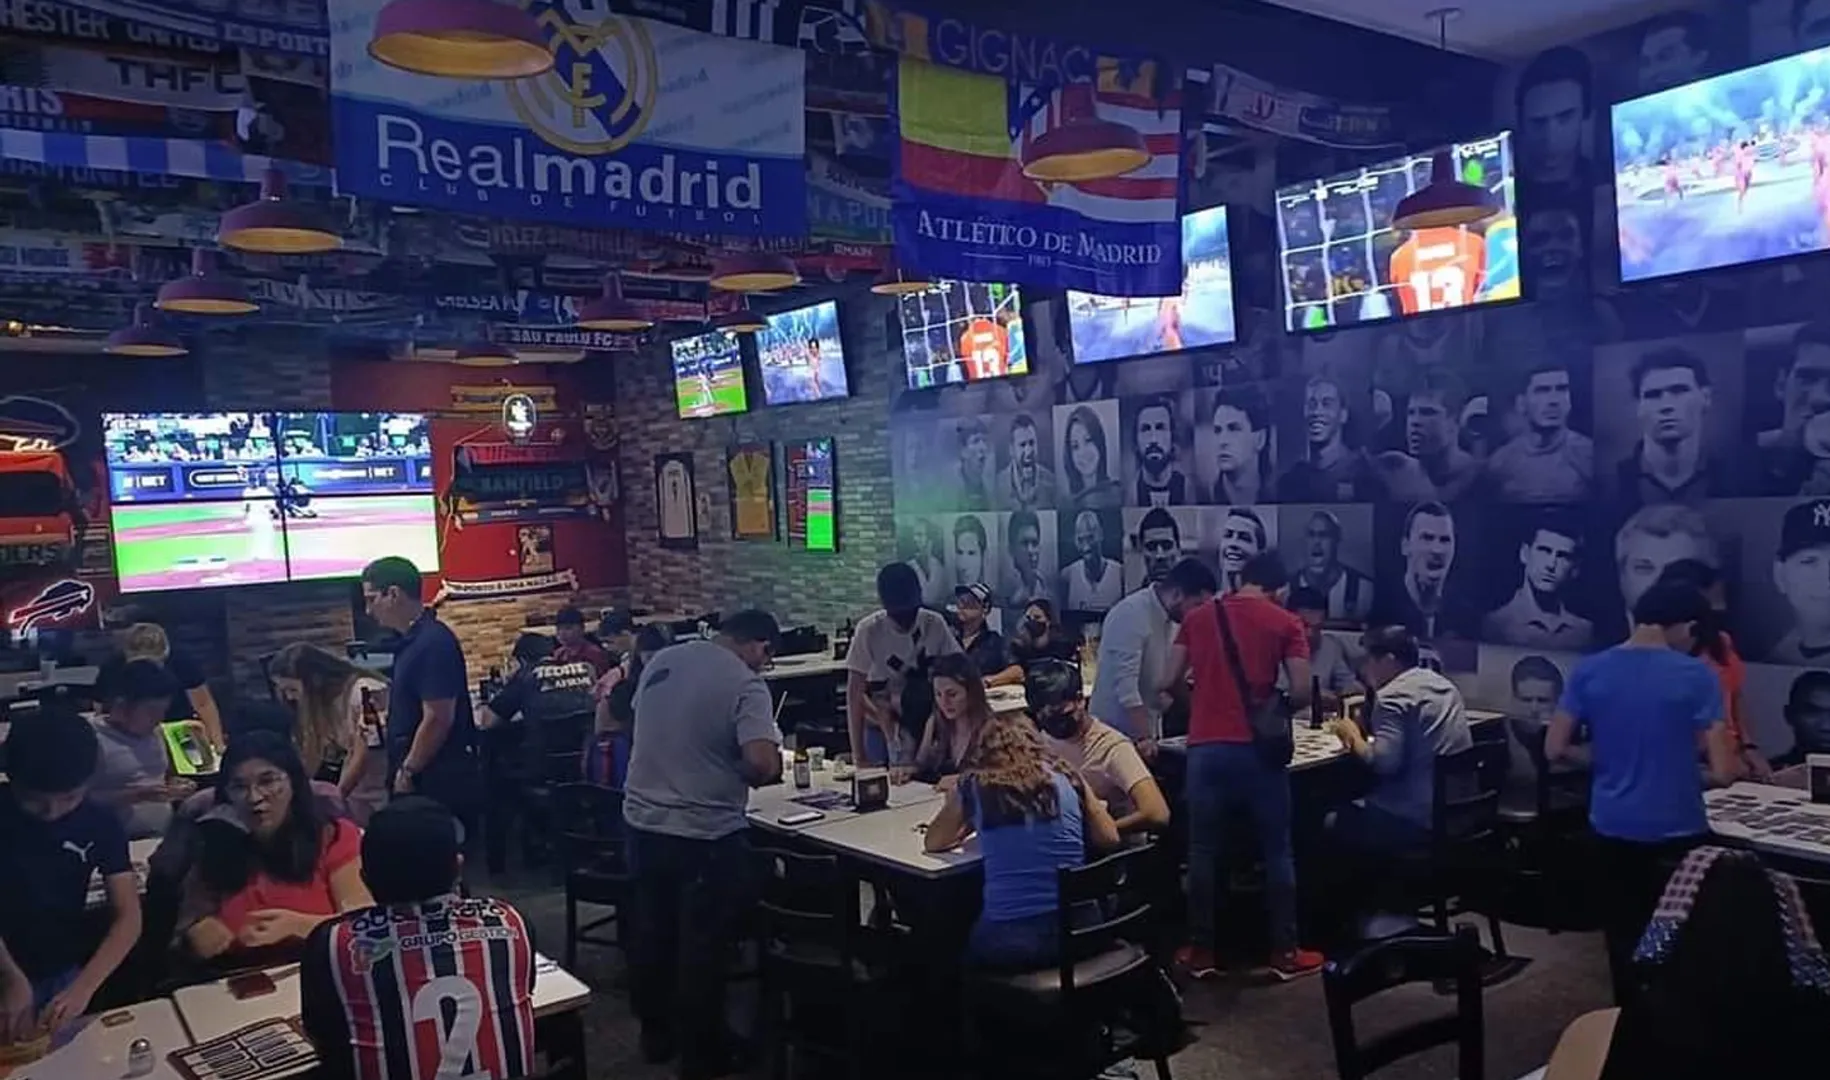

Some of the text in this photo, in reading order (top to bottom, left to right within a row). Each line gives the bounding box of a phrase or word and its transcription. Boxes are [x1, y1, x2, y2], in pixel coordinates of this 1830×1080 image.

[936, 18, 1093, 86] GIGNAC
[107, 56, 248, 94] THFC
[377, 113, 762, 210] Realmadrid
[379, 172, 489, 201] CLUB
[531, 193, 574, 208] DE
[1043, 231, 1073, 255] DE
[1077, 231, 1163, 266] MADRID
[1410, 265, 1465, 312] 13
[593, 332, 612, 346] FC
[401, 929, 460, 949] GRUPO
[412, 974, 492, 1080] 2
